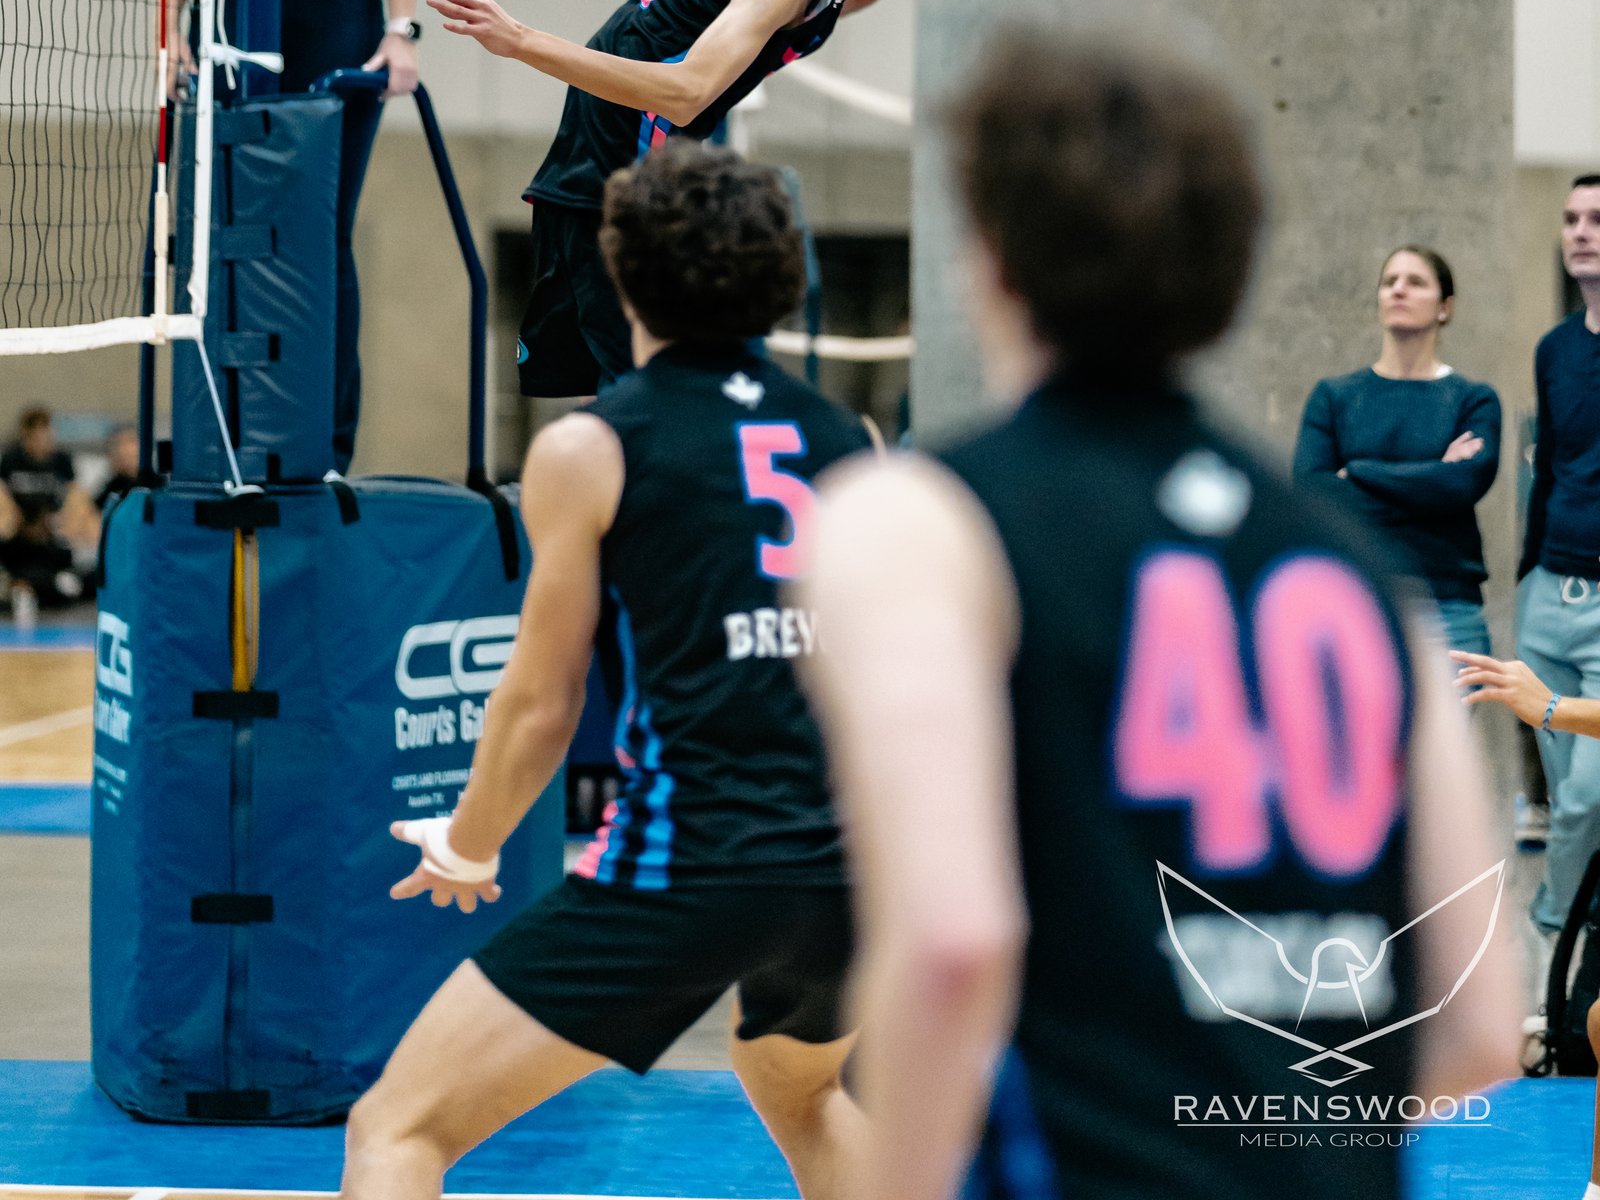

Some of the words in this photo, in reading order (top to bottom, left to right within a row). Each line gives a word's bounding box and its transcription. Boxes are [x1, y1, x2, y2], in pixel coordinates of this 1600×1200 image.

[735, 418, 821, 583] 5
[394, 705, 456, 750] Courts
[1113, 545, 1405, 877] 40
